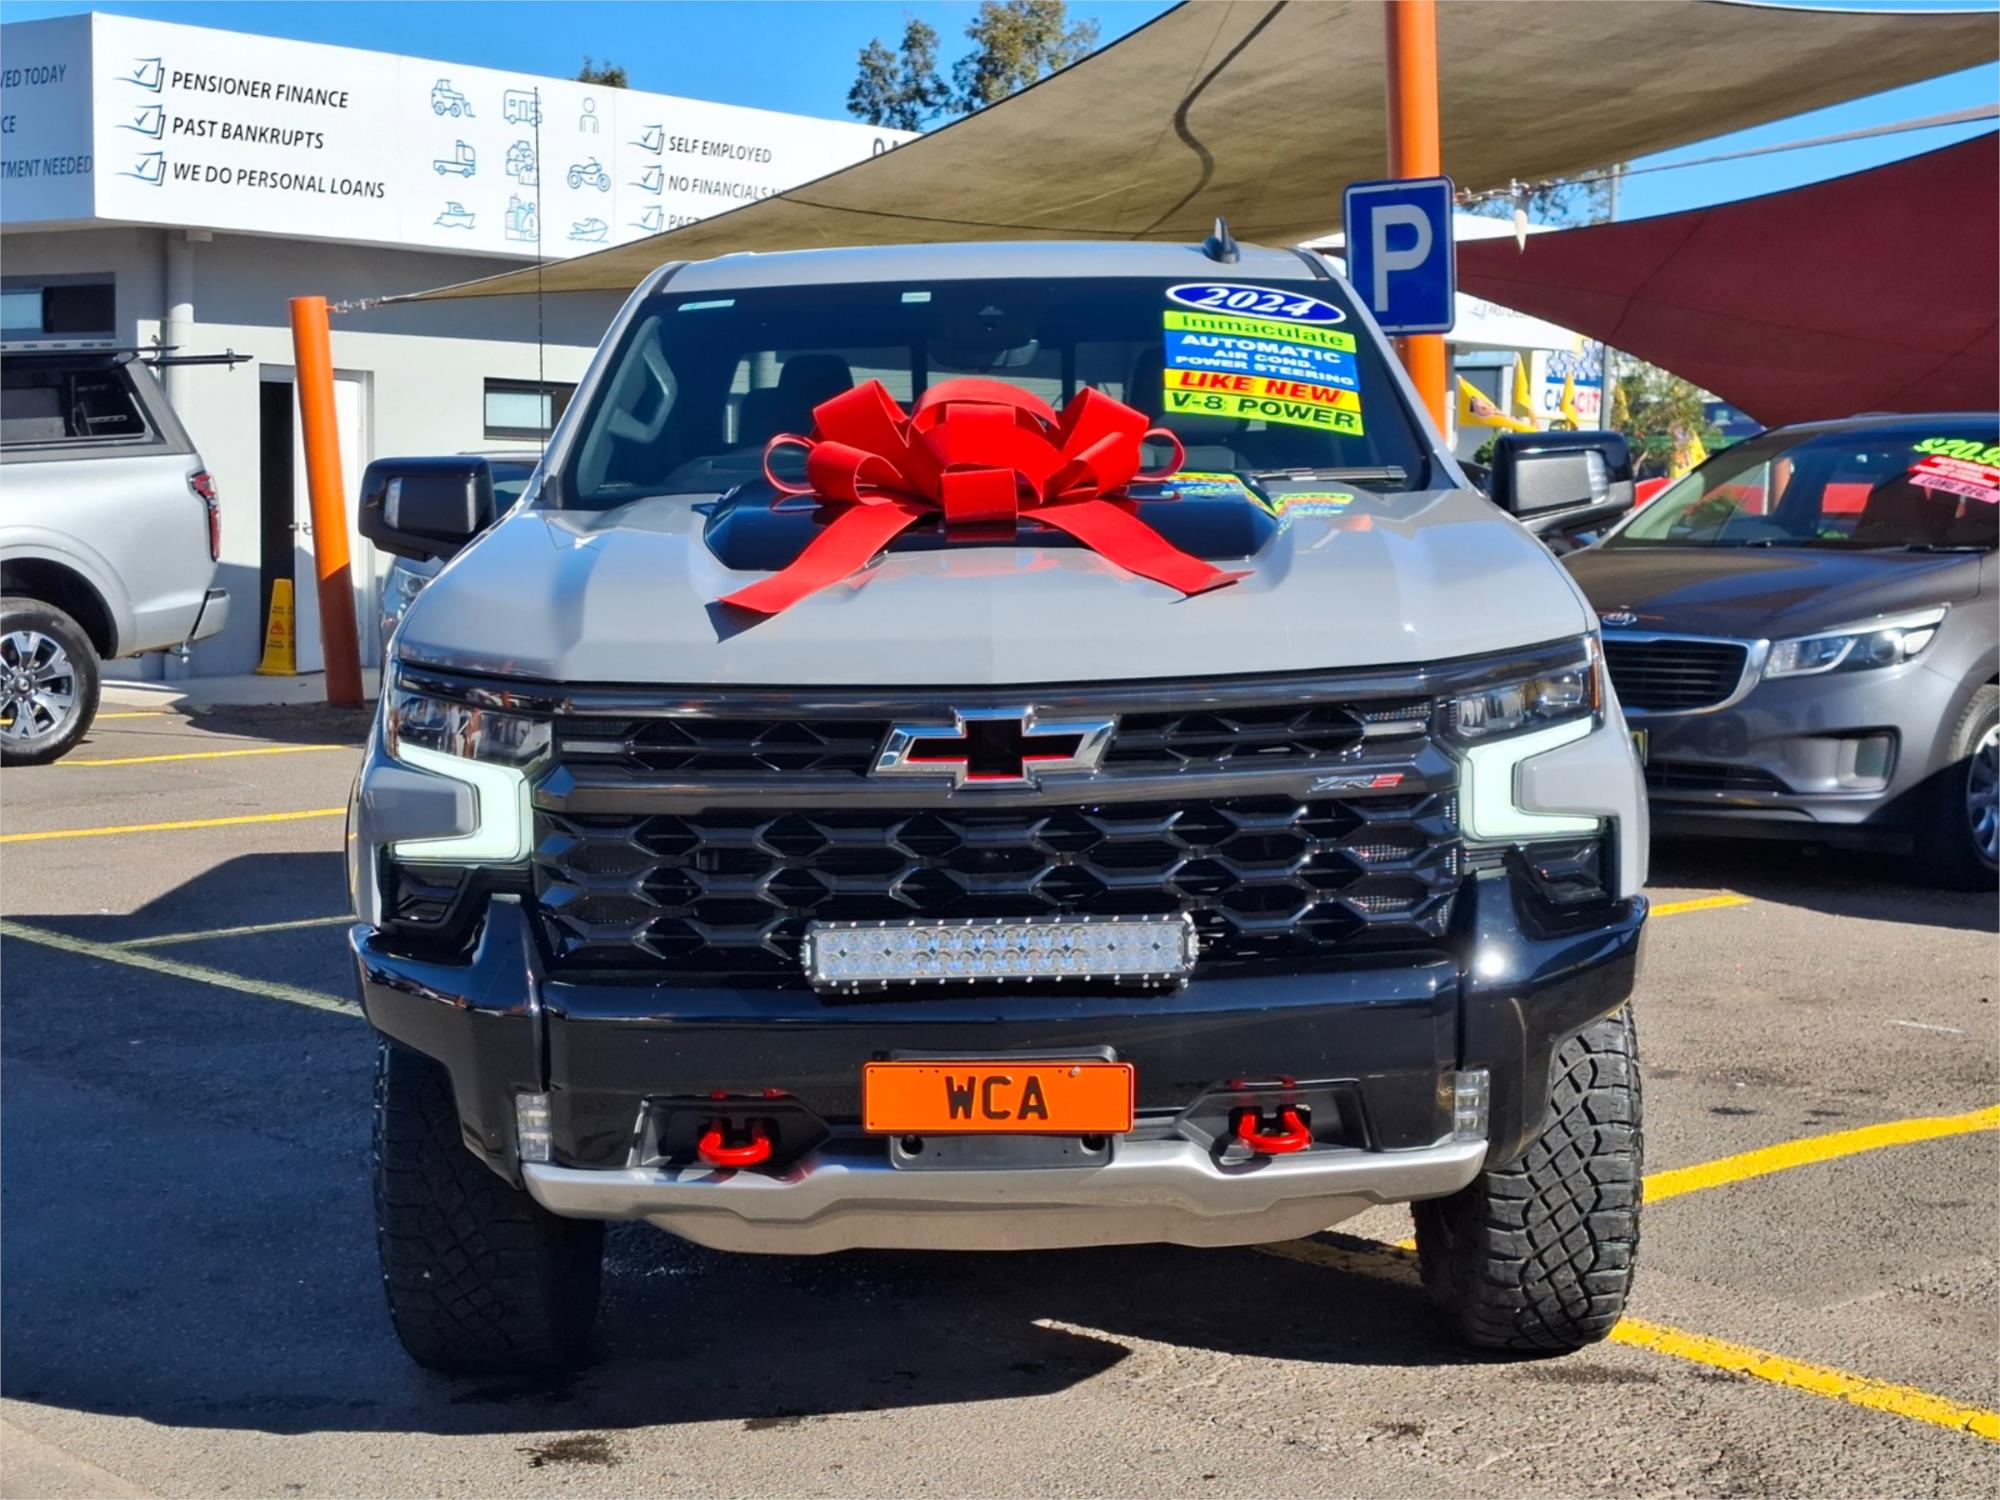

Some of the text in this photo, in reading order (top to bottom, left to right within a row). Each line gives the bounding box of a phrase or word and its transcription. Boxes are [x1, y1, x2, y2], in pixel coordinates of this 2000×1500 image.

[24, 64, 67, 86] TODAY
[171, 71, 349, 108] PENSIONER FINANCE
[172, 117, 324, 149] PAST BANKRUPTS
[669, 136, 772, 163] SELF EMPLOYED
[43, 155, 94, 176] NEEDED
[173, 163, 386, 199] WE DO PERSONAL LOANS
[669, 175, 689, 192] NO
[692, 178, 768, 200] FINANCIALS
[1371, 203, 1433, 312] P
[1195, 287, 1316, 317] 2024
[1182, 315, 1344, 347] Immaculate
[1181, 335, 1341, 364] AUTOMATIC
[1214, 349, 1317, 370] AIR COND.
[1175, 355, 1355, 386] POWER STEERING
[1180, 371, 1342, 404] LIKE NEW
[1576, 391, 1601, 413] CIT
[1172, 392, 1355, 428] V-8 POWER
[945, 1076, 1049, 1120] WCA
